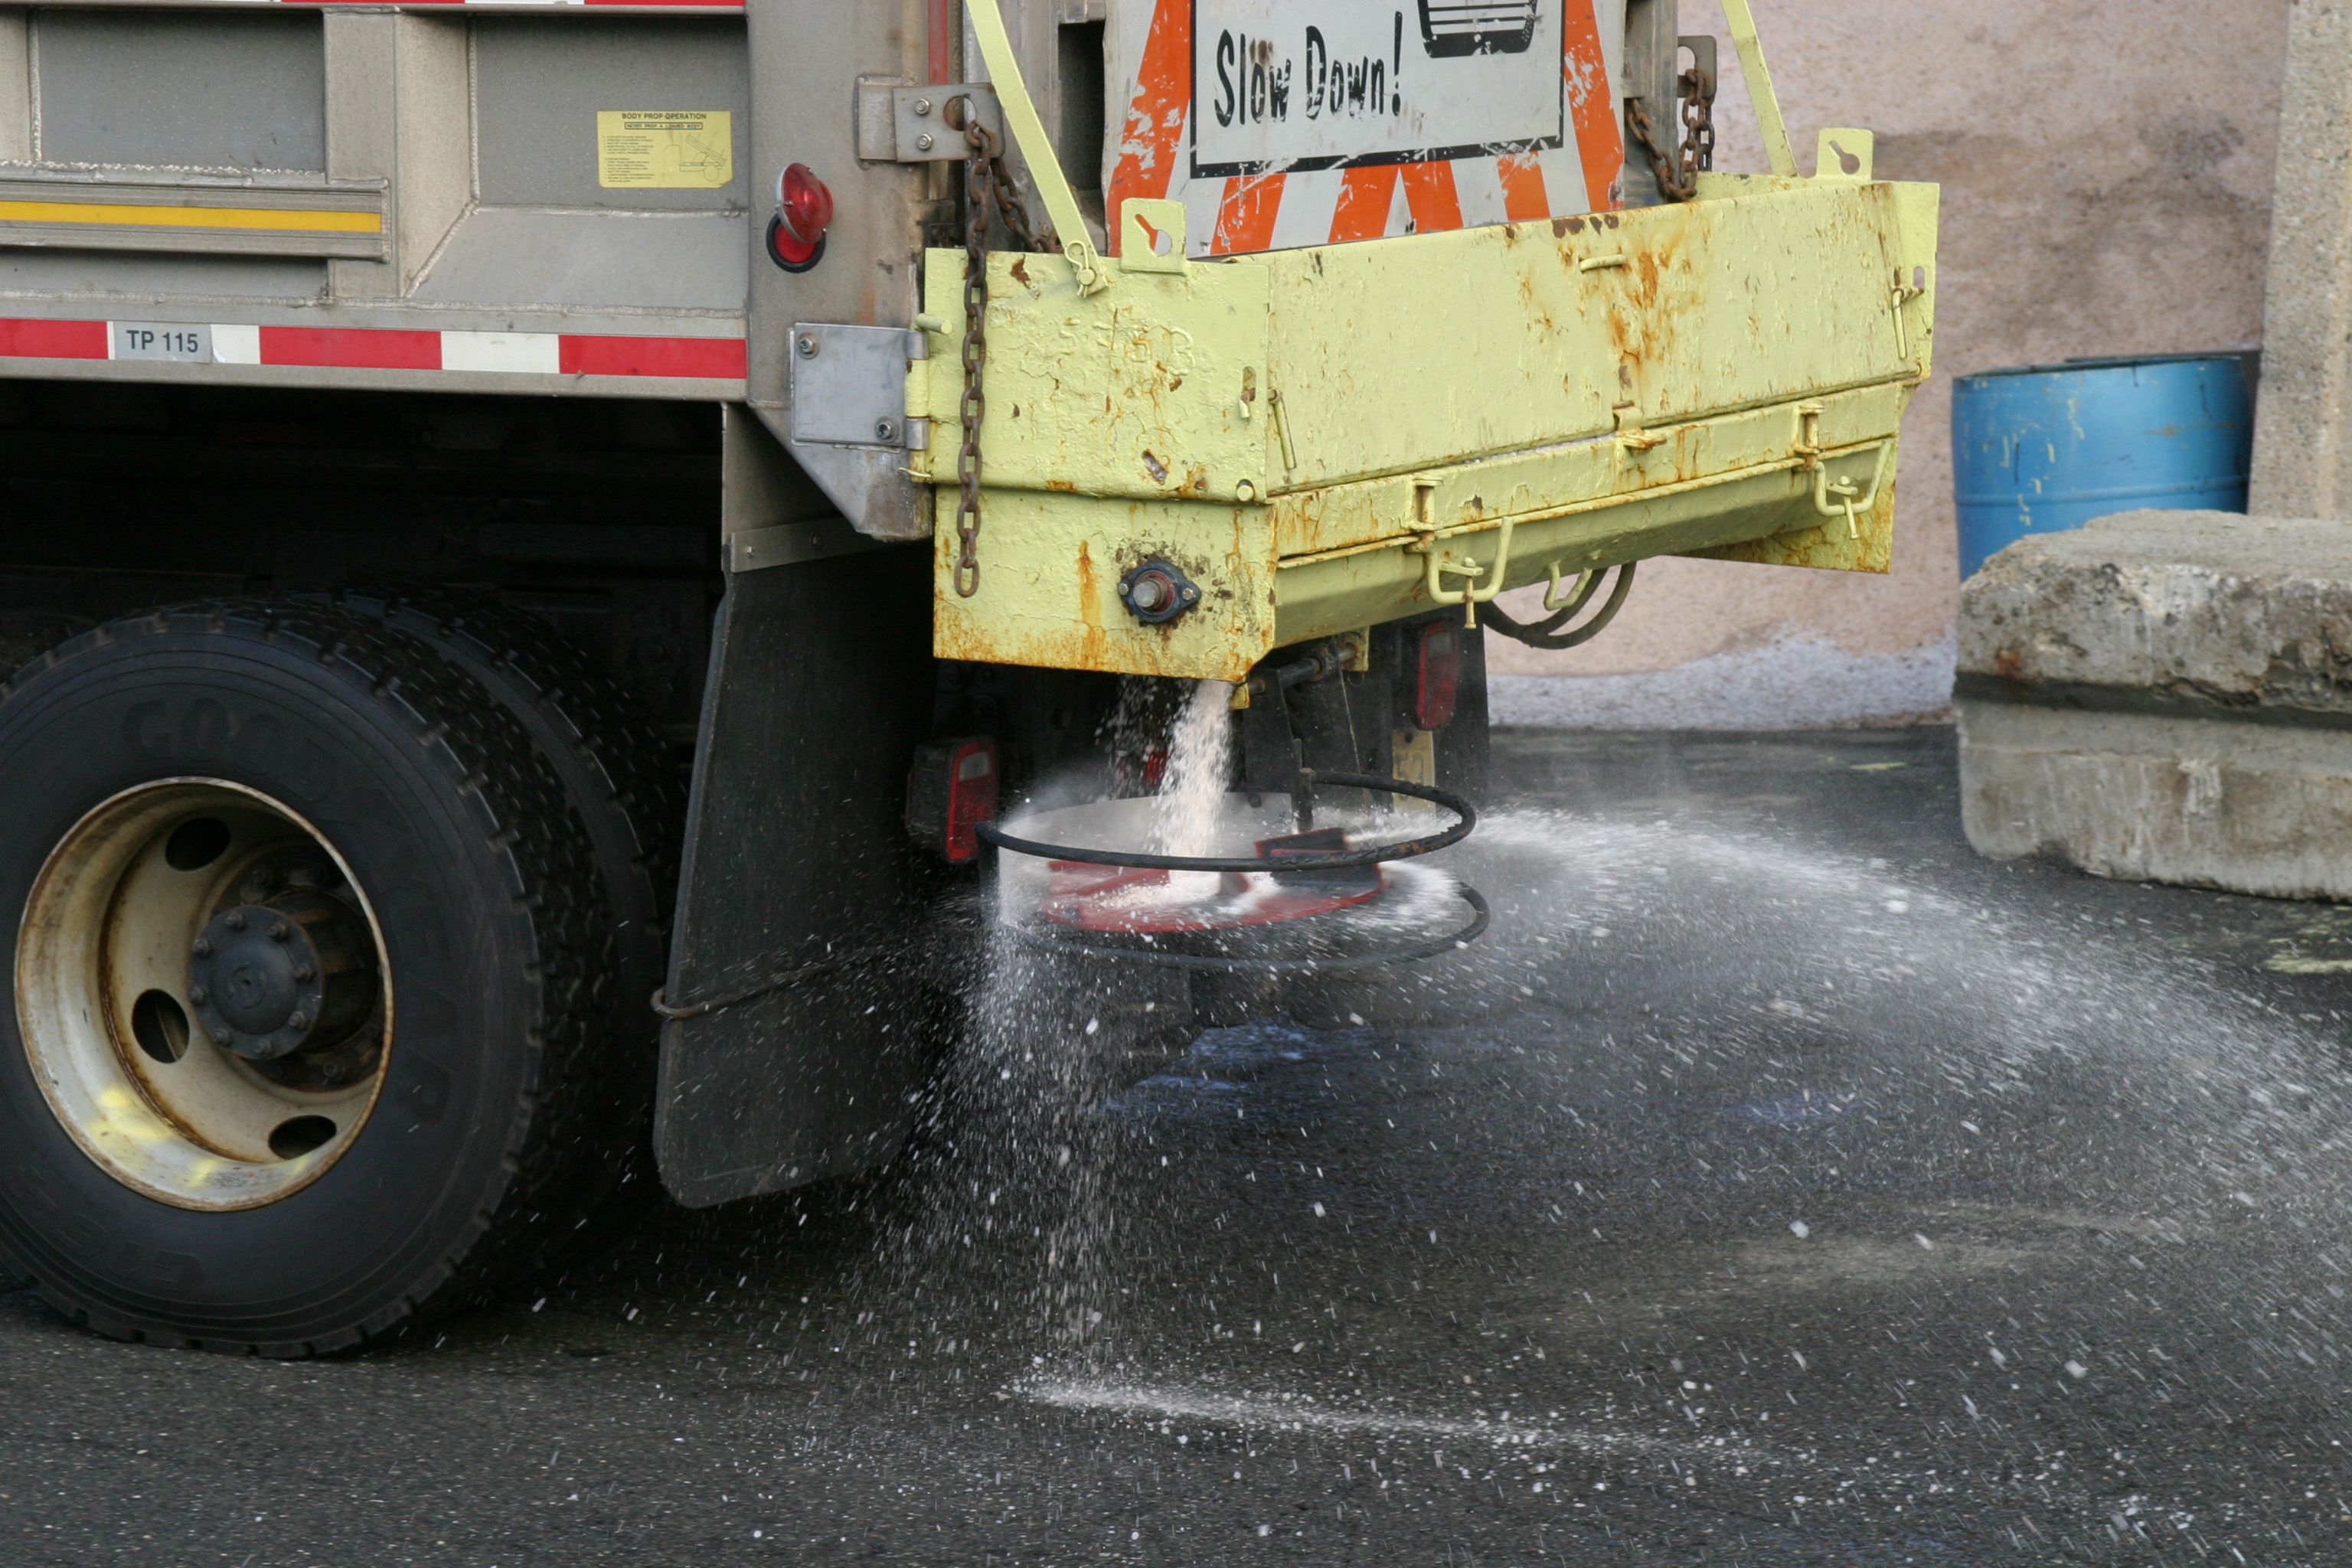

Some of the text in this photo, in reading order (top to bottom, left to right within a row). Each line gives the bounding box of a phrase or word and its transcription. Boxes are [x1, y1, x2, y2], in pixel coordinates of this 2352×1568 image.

[1214, 11, 1403, 128] Slow Down!
[126, 329, 198, 353] TP 115
